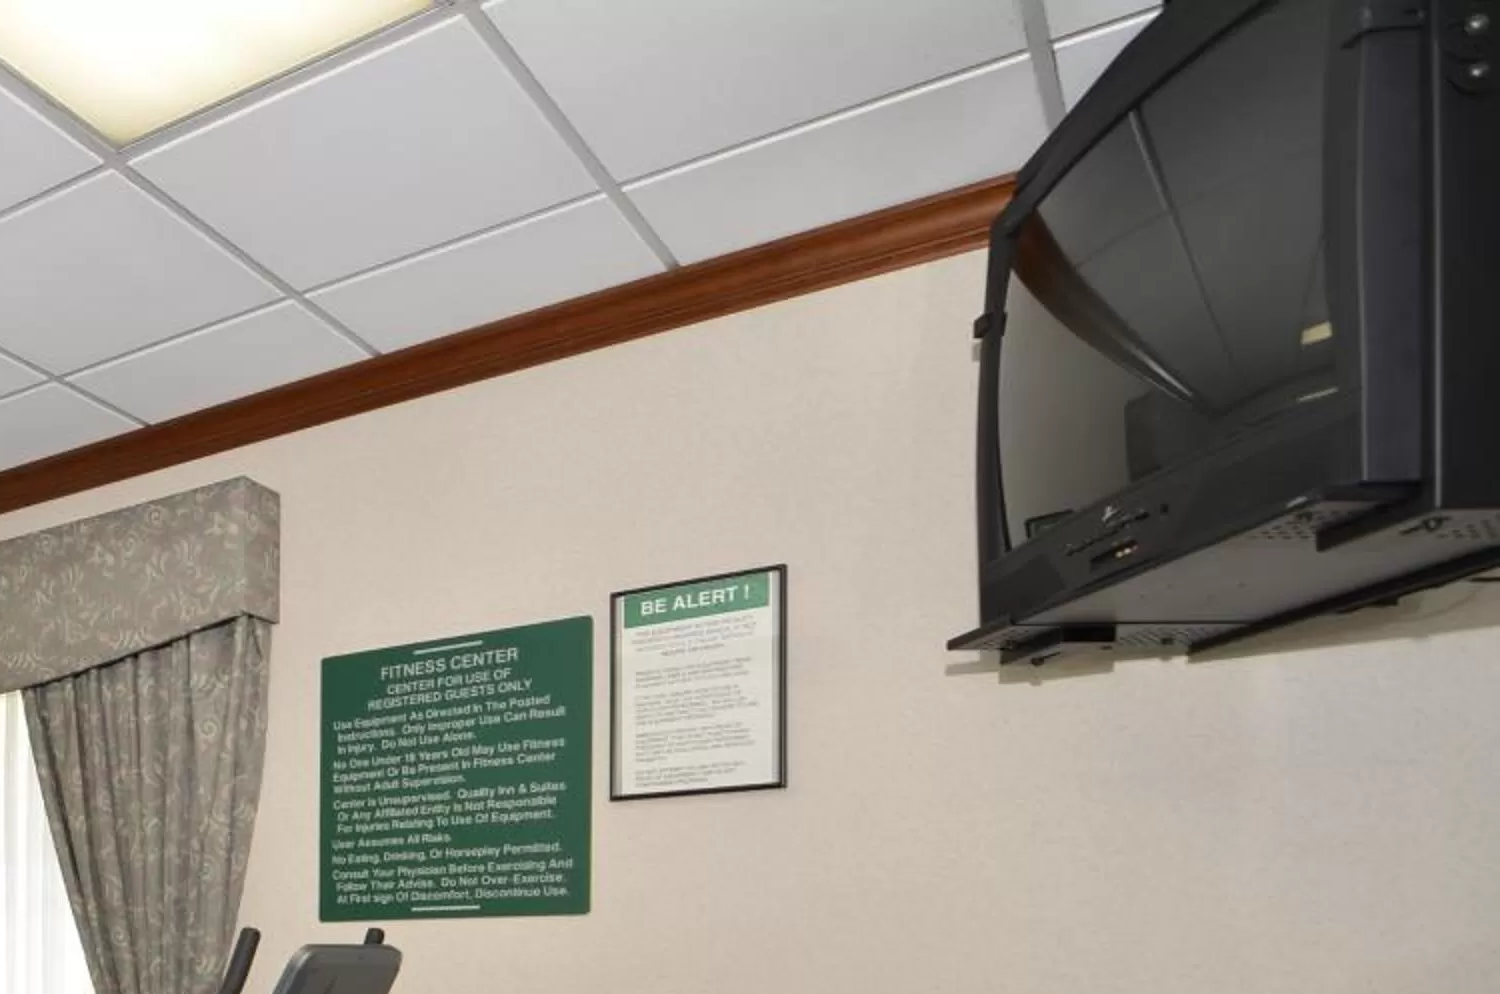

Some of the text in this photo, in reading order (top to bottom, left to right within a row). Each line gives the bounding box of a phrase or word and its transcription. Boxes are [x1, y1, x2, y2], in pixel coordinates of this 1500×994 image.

[641, 597, 667, 616] BE
[672, 585, 739, 611] ALERT
[380, 647, 519, 681] FITNESS CENTER
[386, 667, 512, 695] CENTER FOR USE OF
[367, 678, 532, 712] REGISTERED GUESTS ONLY
[333, 720, 352, 731] Use
[484, 701, 506, 712] The
[509, 694, 551, 709] Posted
[478, 715, 501, 726] Use
[503, 711, 527, 723] Can
[529, 705, 566, 720] Result
[381, 739, 397, 750] Do
[419, 735, 440, 745] Use
[471, 744, 496, 757] May
[497, 741, 521, 753] Use
[386, 766, 400, 777] Or
[473, 757, 515, 769] Fitness
[516, 752, 556, 765] Center
[332, 799, 365, 810] Center
[457, 787, 495, 799] Quality
[497, 785, 515, 796] Inn
[463, 801, 486, 812] Not
[435, 815, 449, 827] To
[451, 815, 473, 826] Use
[428, 847, 443, 859] Or
[444, 846, 501, 858] Horseplay
[487, 860, 547, 873] Exercising
[547, 857, 574, 869] And
[440, 877, 457, 888] Do
[481, 874, 509, 885] Over
[474, 886, 541, 899] Discontinue
